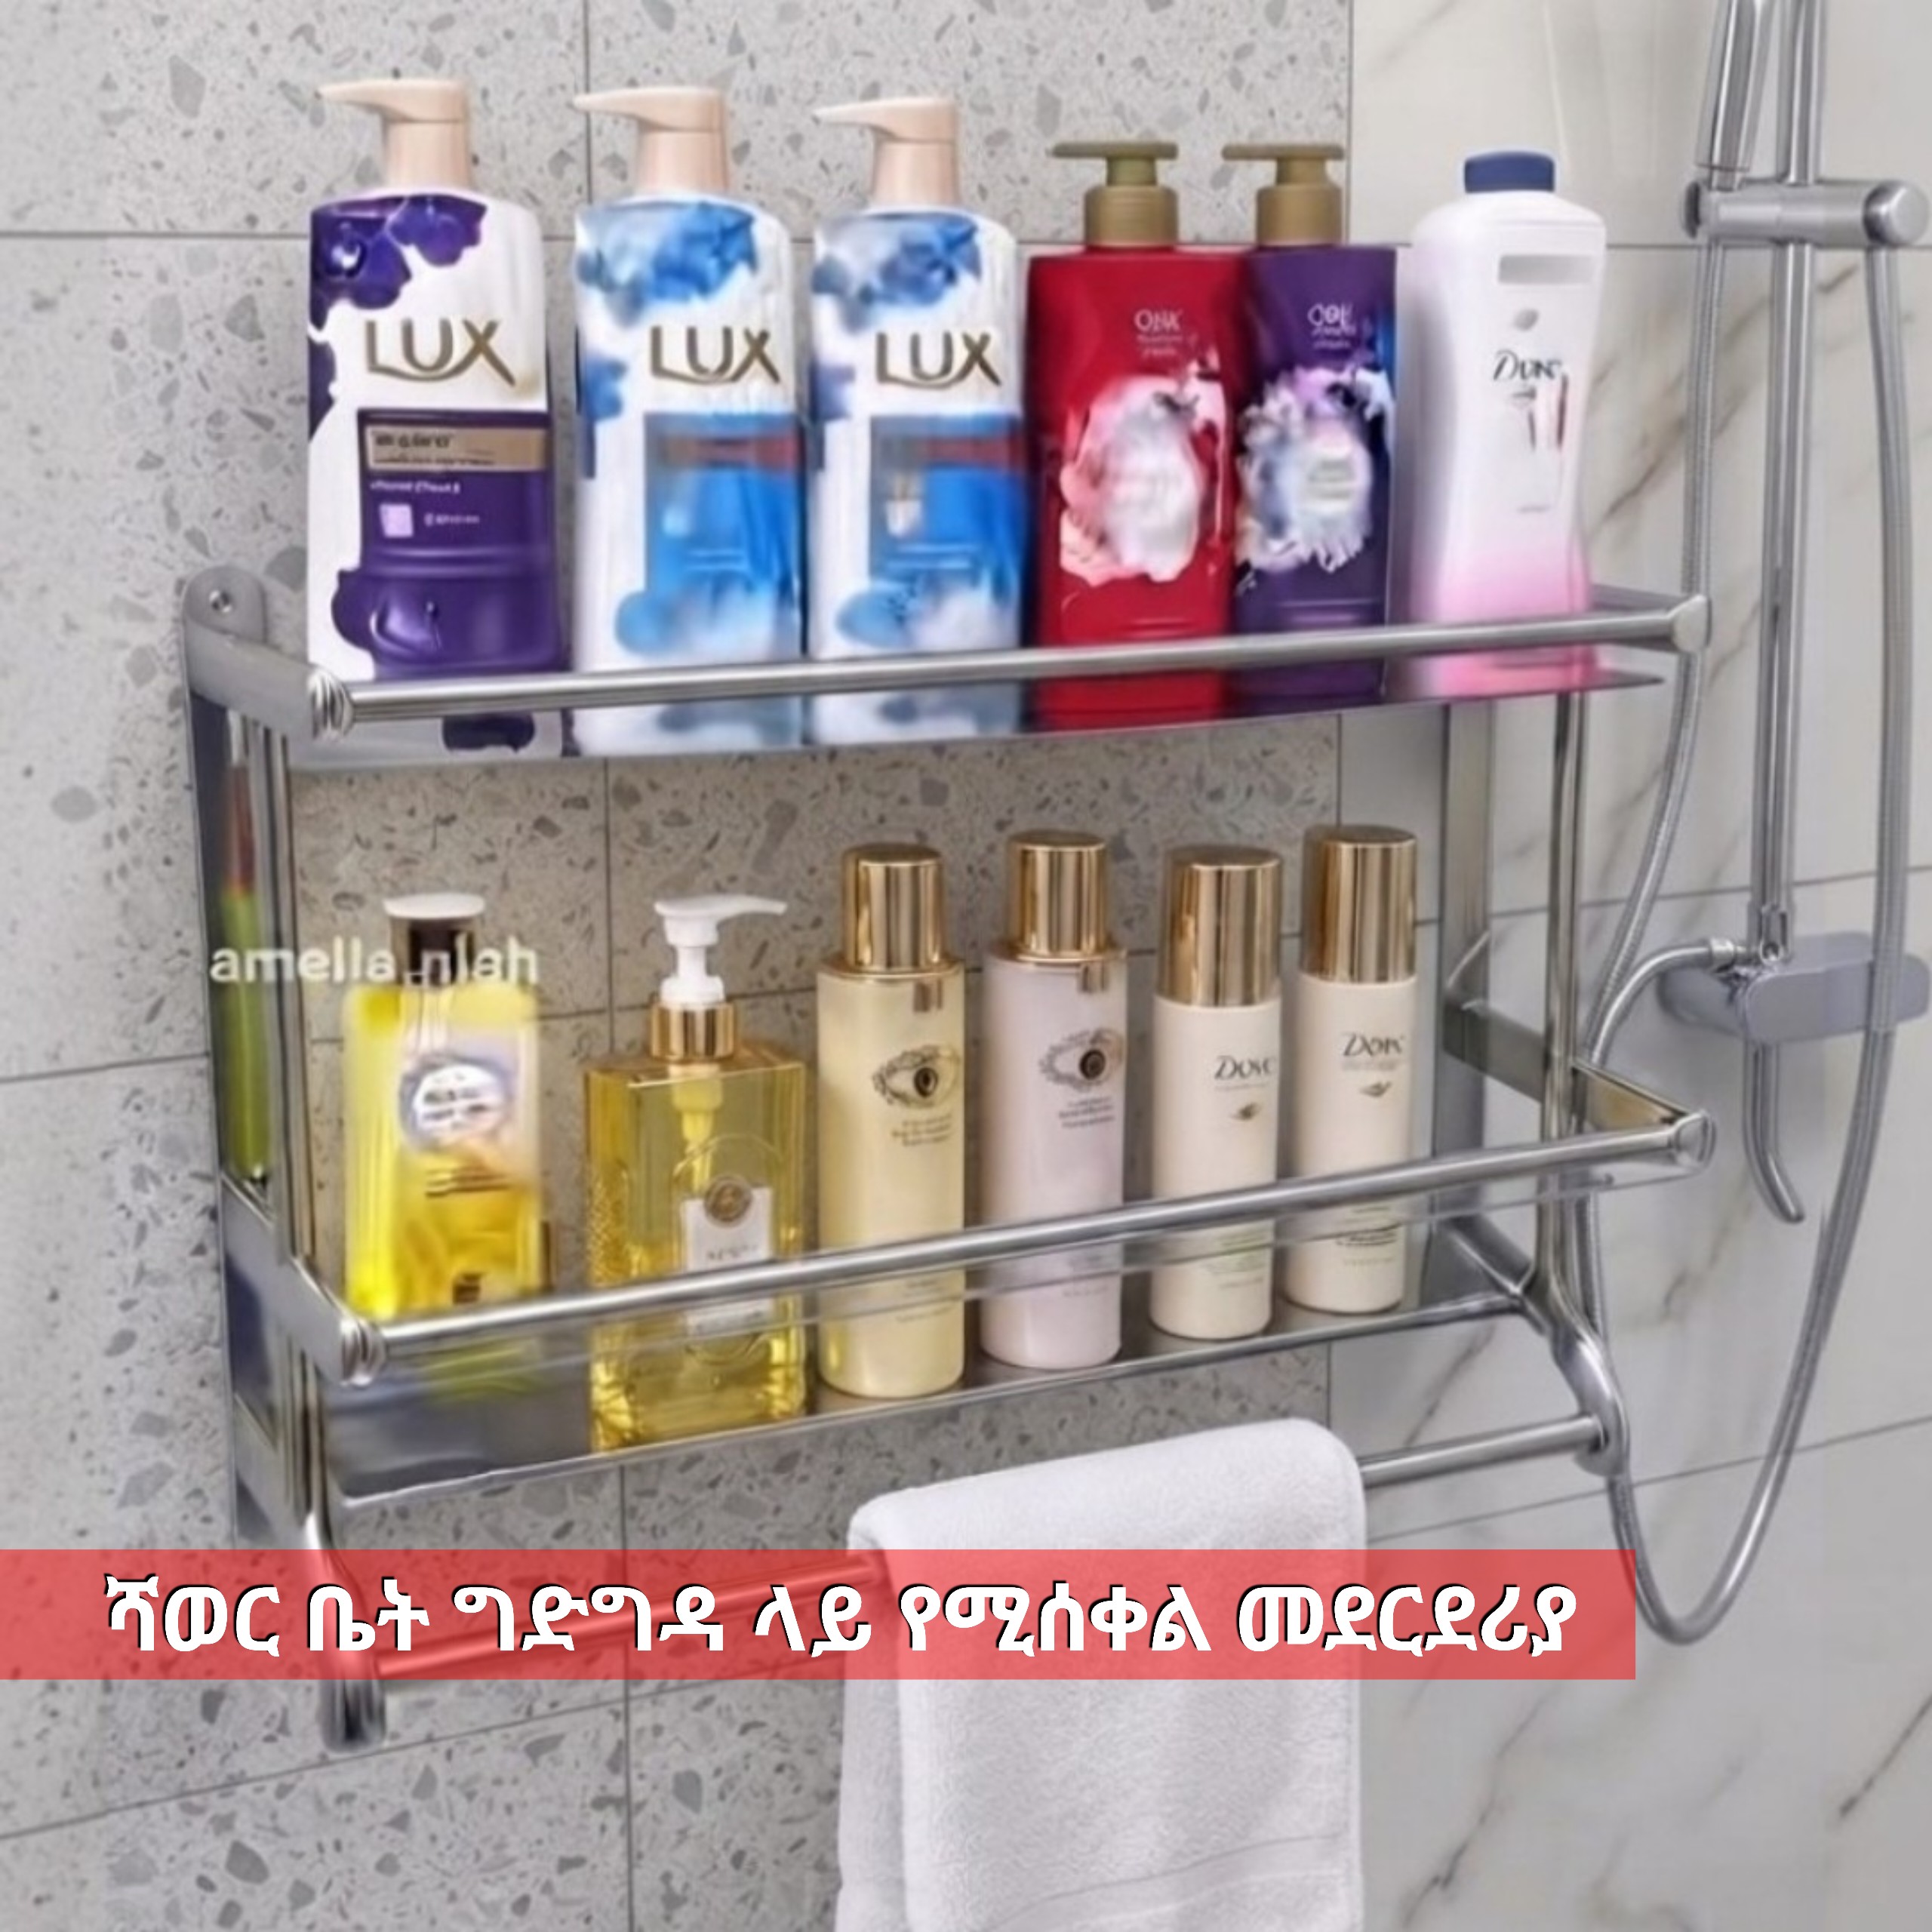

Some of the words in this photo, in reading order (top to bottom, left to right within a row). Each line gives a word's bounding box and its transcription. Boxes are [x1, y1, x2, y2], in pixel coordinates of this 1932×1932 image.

[365, 318, 518, 388] LUX
[650, 325, 782, 385] LUX
[875, 331, 1001, 389] LUX
